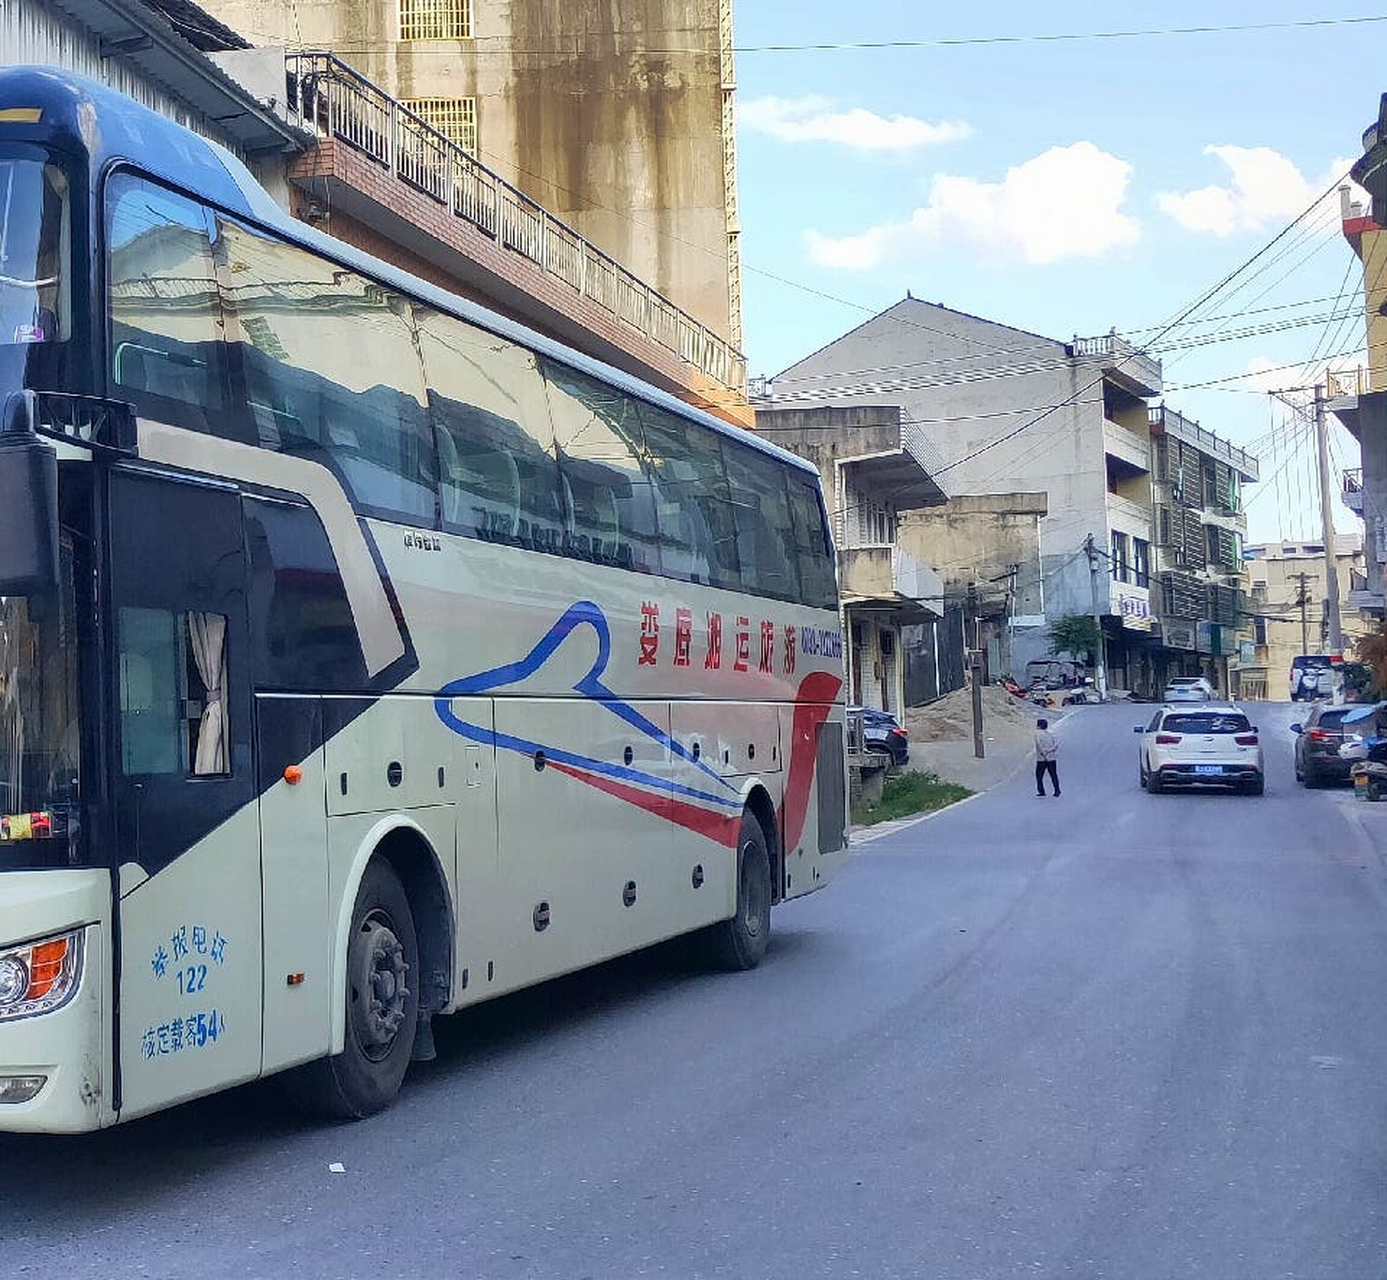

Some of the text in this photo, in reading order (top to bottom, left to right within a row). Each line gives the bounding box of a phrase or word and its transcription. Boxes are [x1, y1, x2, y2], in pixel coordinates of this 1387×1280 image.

[638, 600, 796, 675] 娄底湘运旅游
[177, 964, 207, 995] 122
